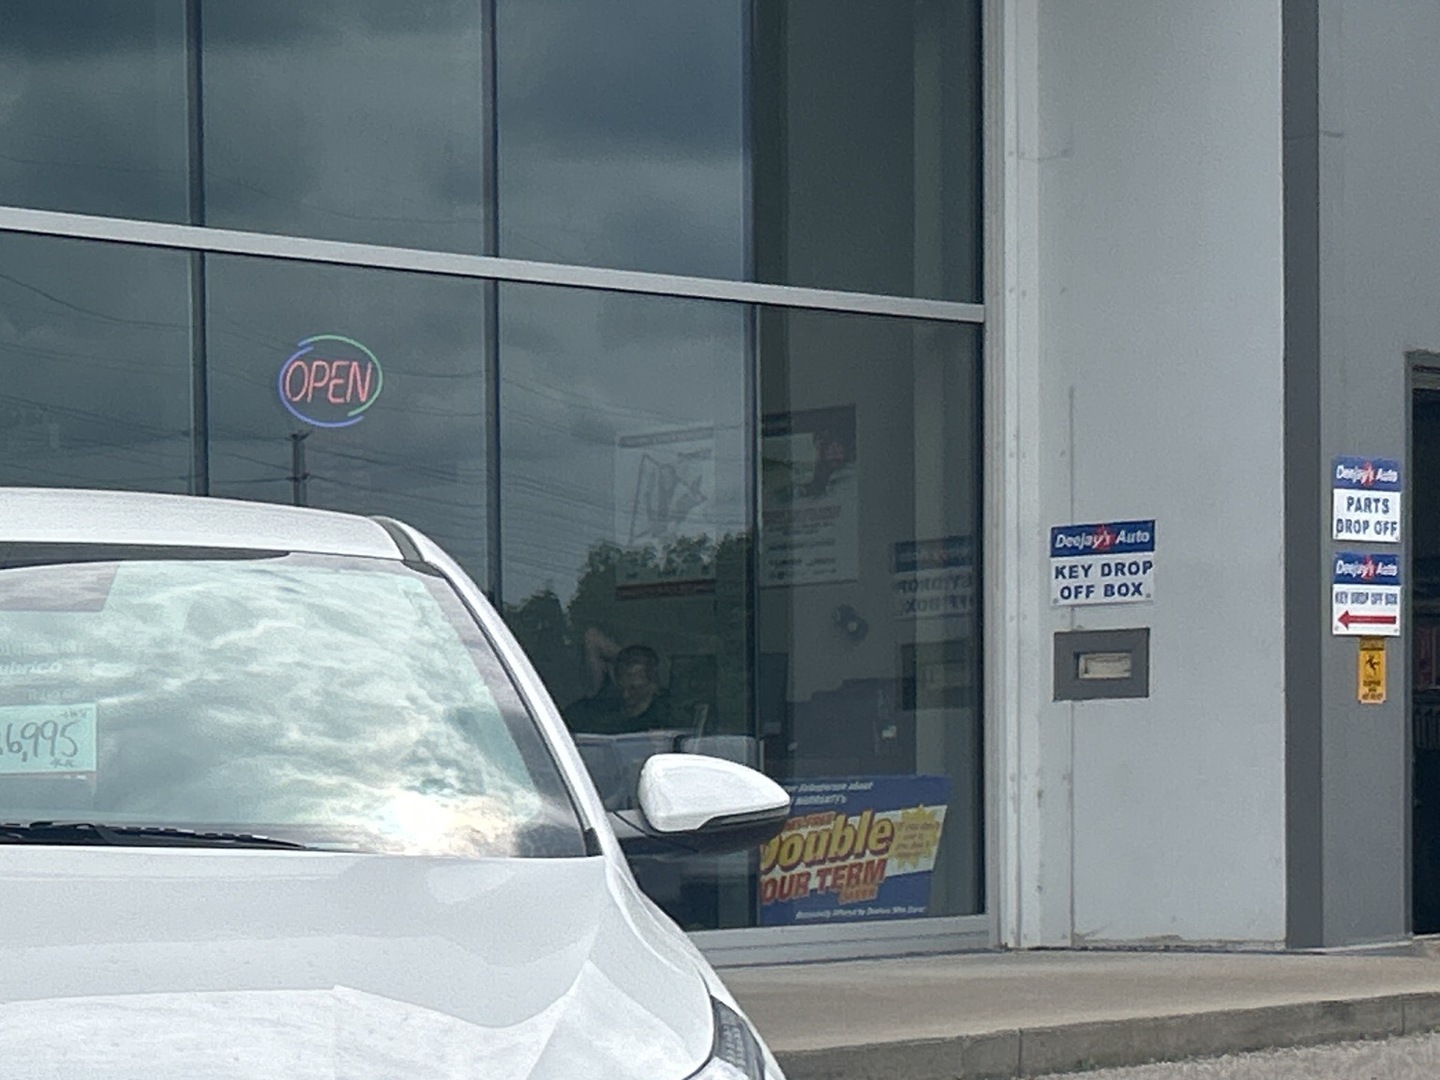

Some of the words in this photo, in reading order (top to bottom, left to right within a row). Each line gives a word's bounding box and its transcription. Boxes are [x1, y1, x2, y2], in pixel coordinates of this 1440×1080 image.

[285, 360, 372, 403] OPEN
[1346, 496, 1390, 514] PARTS
[1336, 518, 1370, 534] DROP
[1374, 520, 1398, 535] OFF
[1055, 530, 1112, 551] Deejay's
[1115, 529, 1150, 544] Auto
[1054, 564, 1093, 579] KEY
[1101, 561, 1153, 577] DROP
[1060, 585, 1095, 600] OFF
[1104, 582, 1143, 597] BOX
[817, 859, 889, 893] TERM
